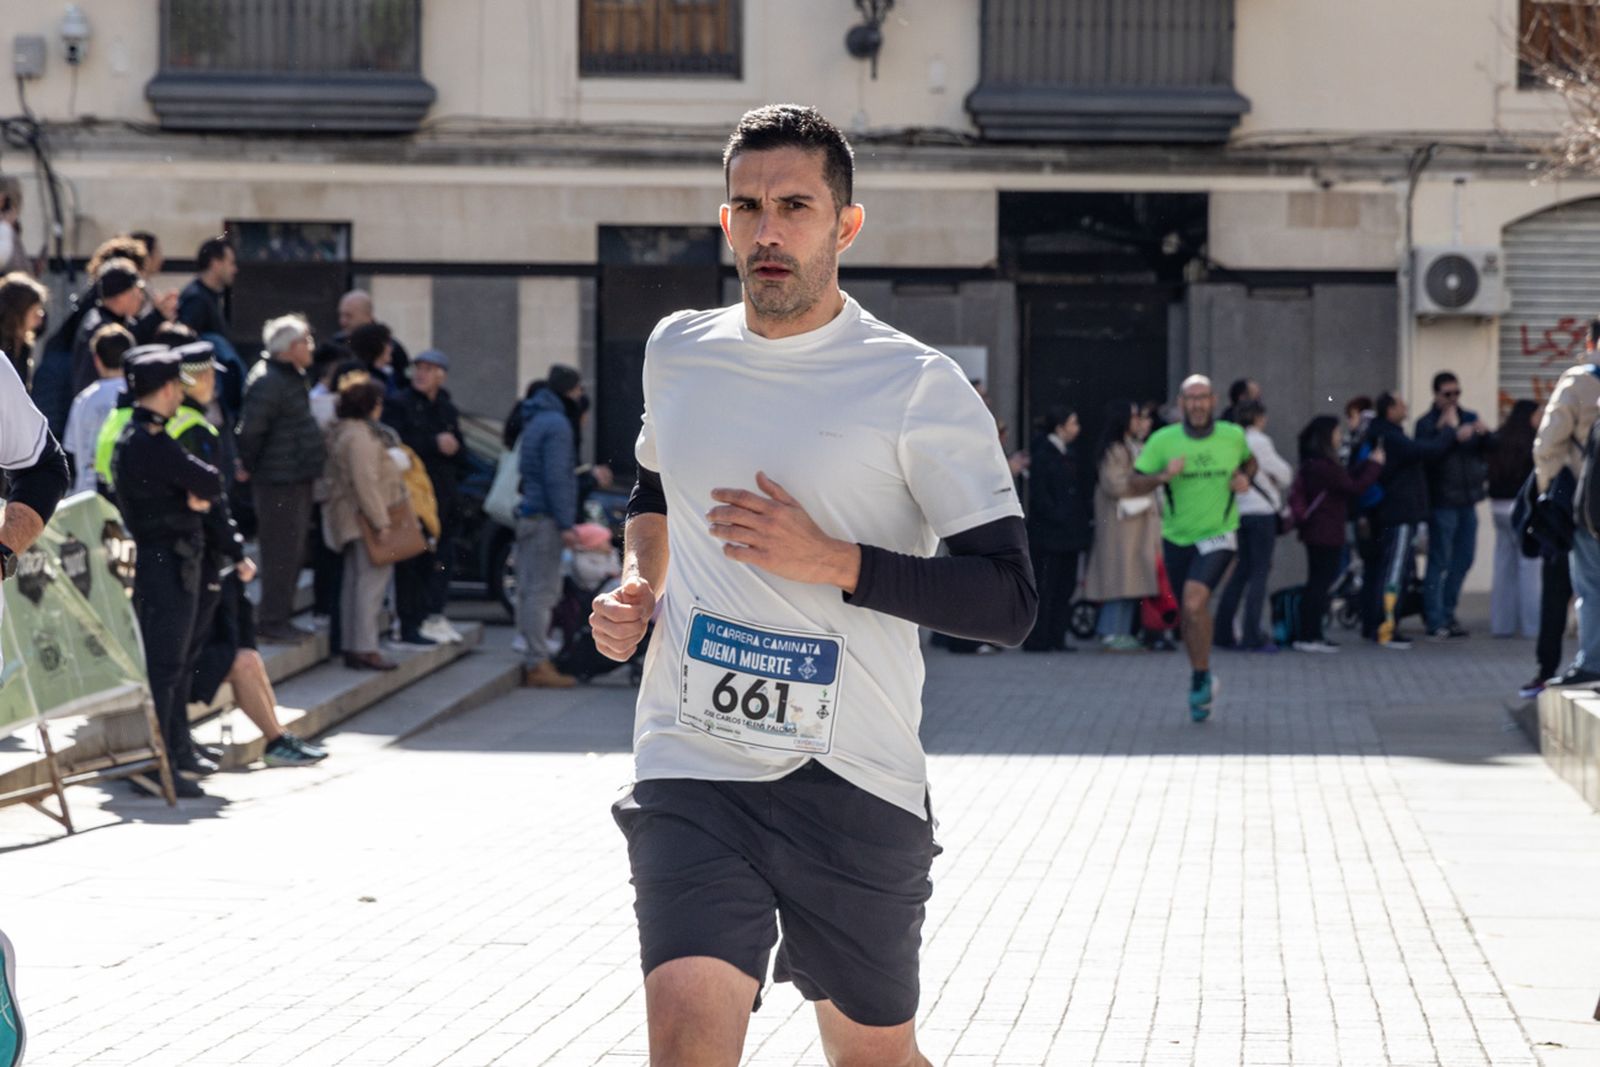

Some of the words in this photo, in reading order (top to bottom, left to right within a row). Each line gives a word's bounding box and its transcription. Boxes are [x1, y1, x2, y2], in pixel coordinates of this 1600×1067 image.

[706, 621, 715, 634] VI
[716, 624, 760, 647] CARRERA
[762, 637, 821, 656] CAMINATA
[701, 638, 736, 665] BUENA
[739, 649, 793, 676] MUERTE
[712, 671, 790, 724] 661
[716, 713, 741, 726] CARLOS
[767, 723, 798, 735] PALOMO
